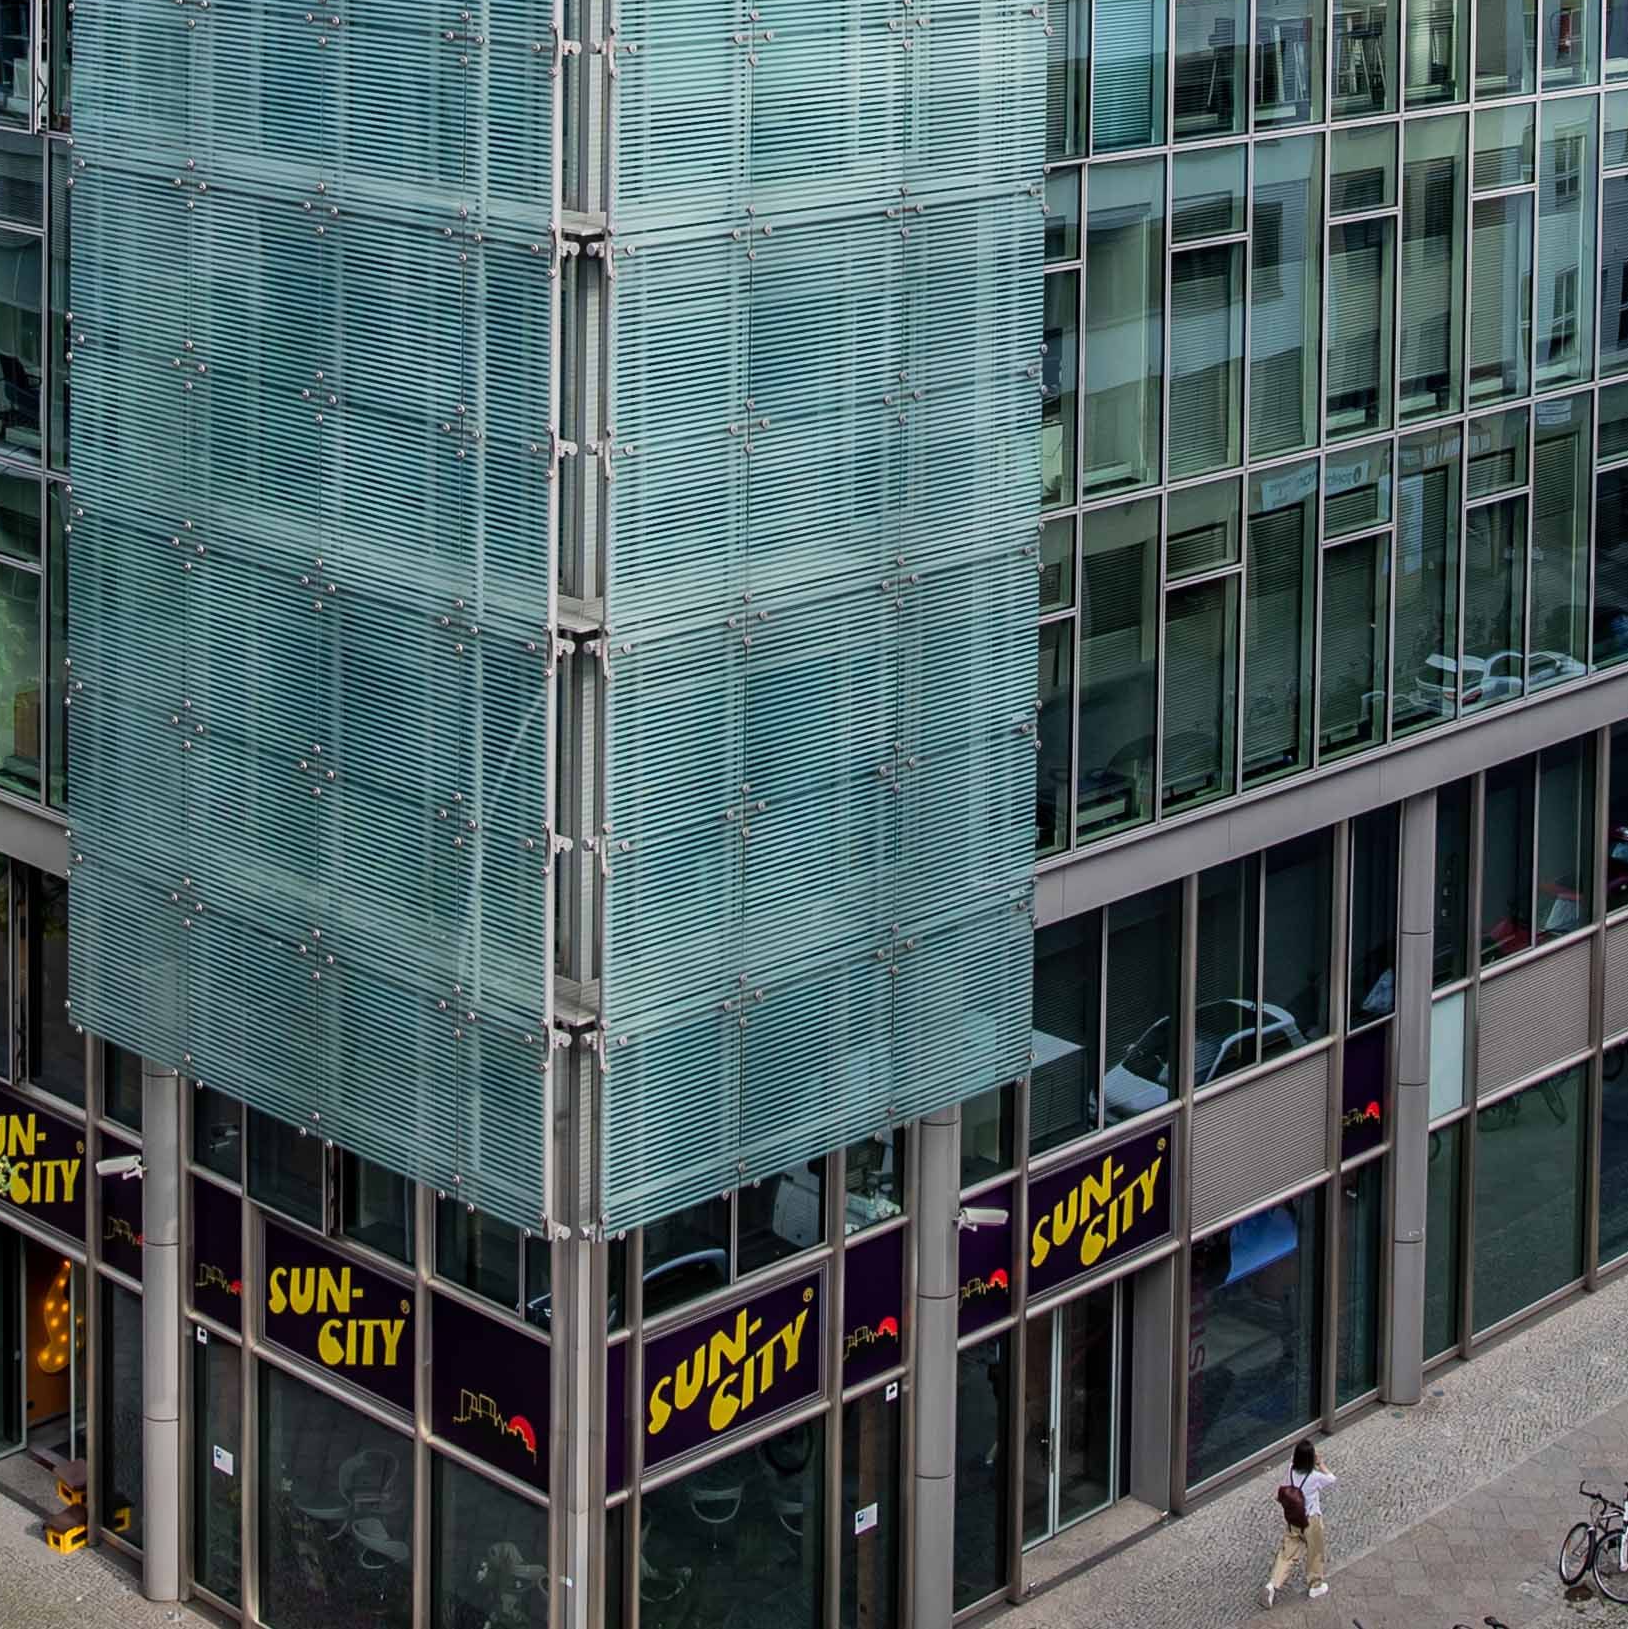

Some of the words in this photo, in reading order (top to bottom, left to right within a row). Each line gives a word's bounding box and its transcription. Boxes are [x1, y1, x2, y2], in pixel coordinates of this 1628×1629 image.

[9, 1159, 81, 1204] CITY
[1031, 1155, 1124, 1268] SUN-
[1080, 1156, 1162, 1266] CITY
[269, 1267, 363, 1315] SUN-
[318, 1318, 405, 1365] CITY
[648, 1308, 762, 1435] SUN-
[709, 1308, 808, 1431] CITY
